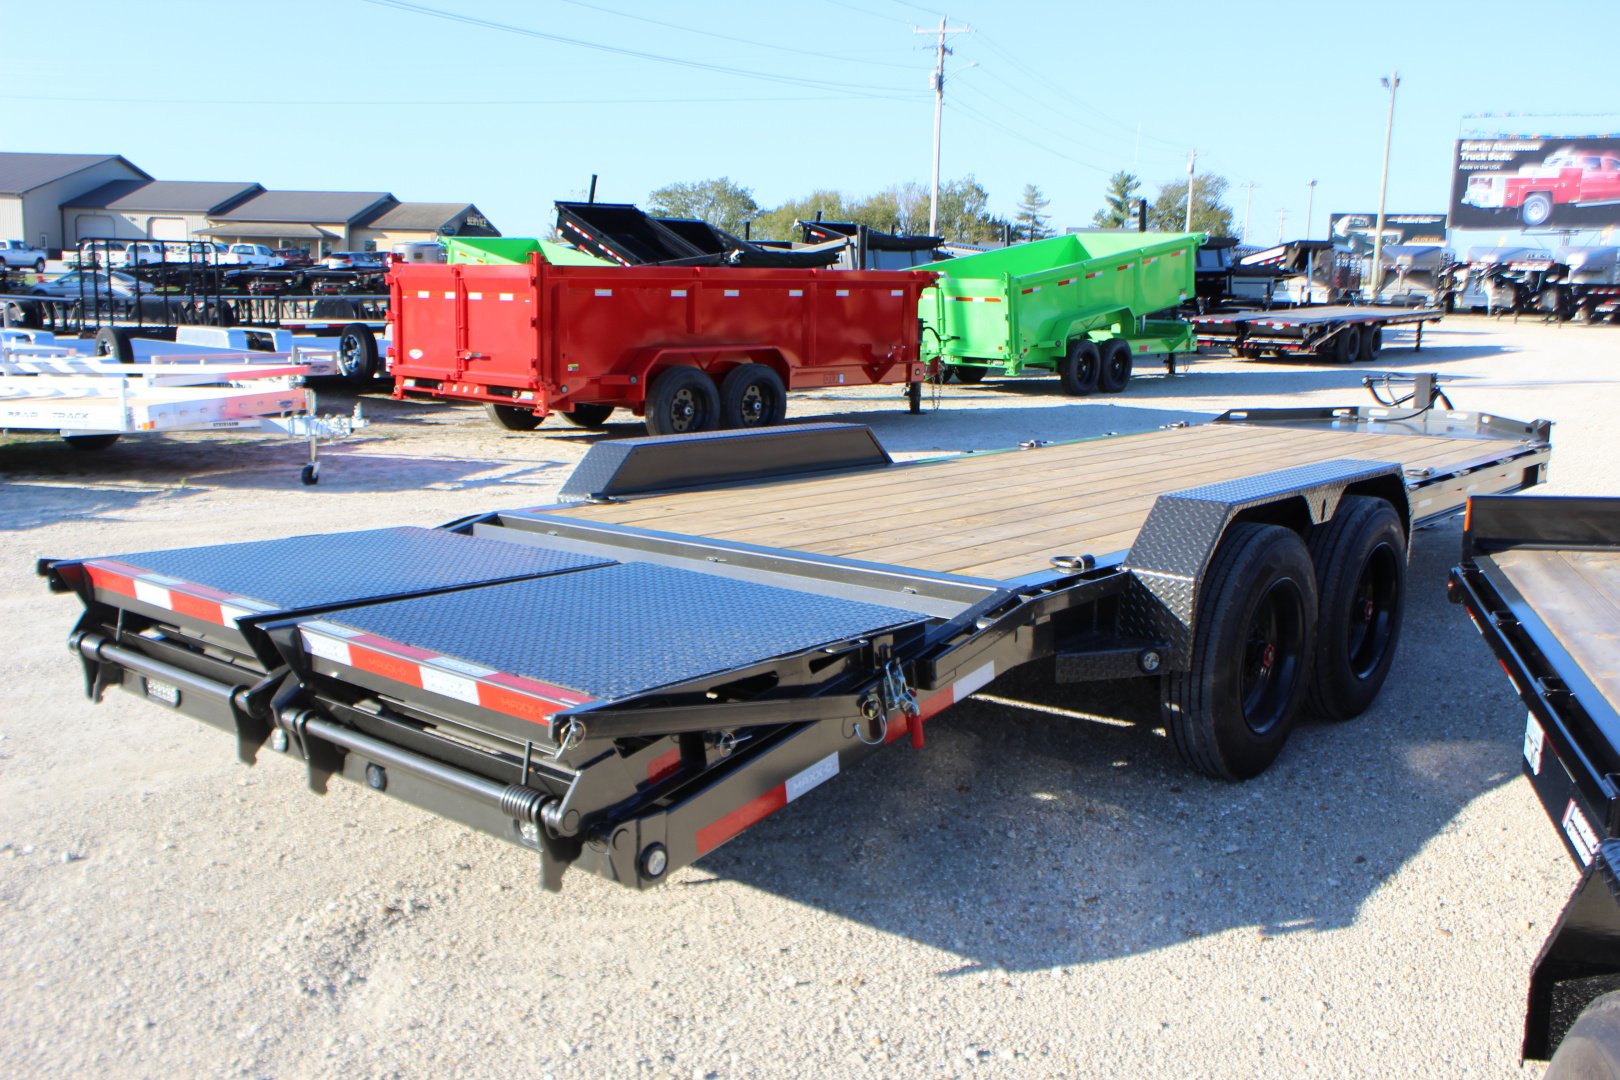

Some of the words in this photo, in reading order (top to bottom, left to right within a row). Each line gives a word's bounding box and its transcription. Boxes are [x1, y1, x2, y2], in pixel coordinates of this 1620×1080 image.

[1461, 143, 1491, 151] Martin
[1492, 143, 1540, 151] Aluminum
[1460, 153, 1487, 161] Truck
[466, 216, 488, 227] SERVICE
